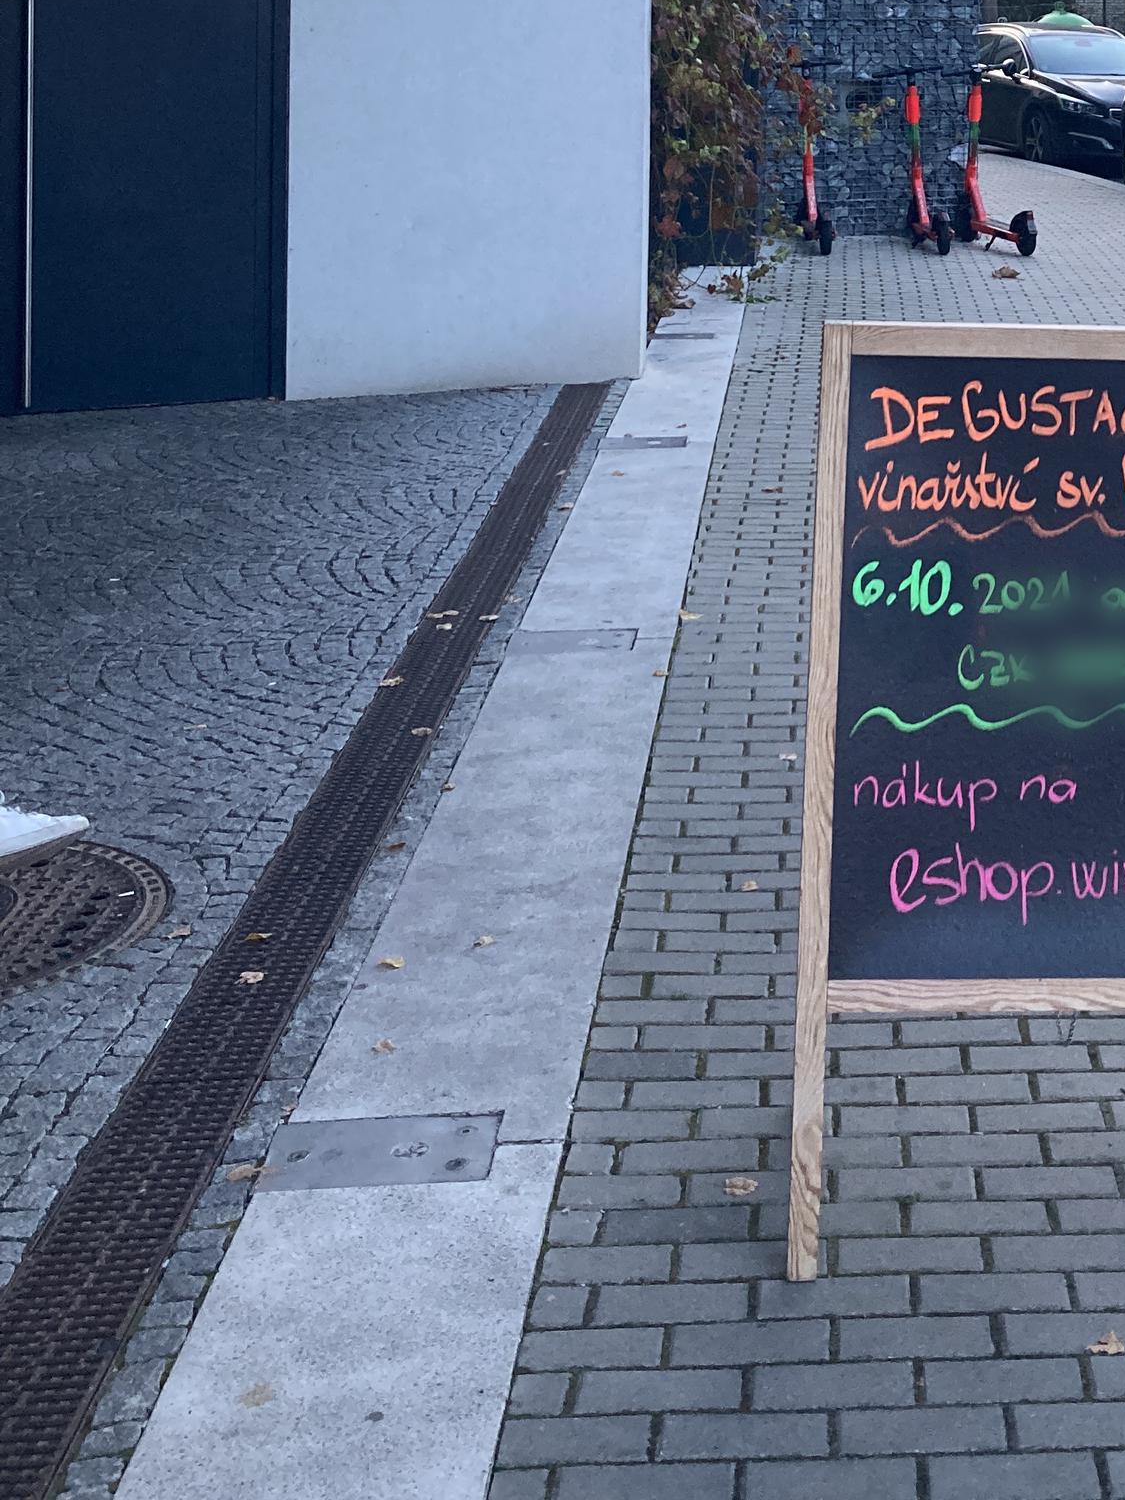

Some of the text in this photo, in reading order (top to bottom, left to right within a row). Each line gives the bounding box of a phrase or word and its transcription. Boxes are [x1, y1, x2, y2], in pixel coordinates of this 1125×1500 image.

[857, 452, 1040, 513] vinařství
[1056, 470, 1106, 511] sv.
[854, 759, 1078, 832] nákup na
